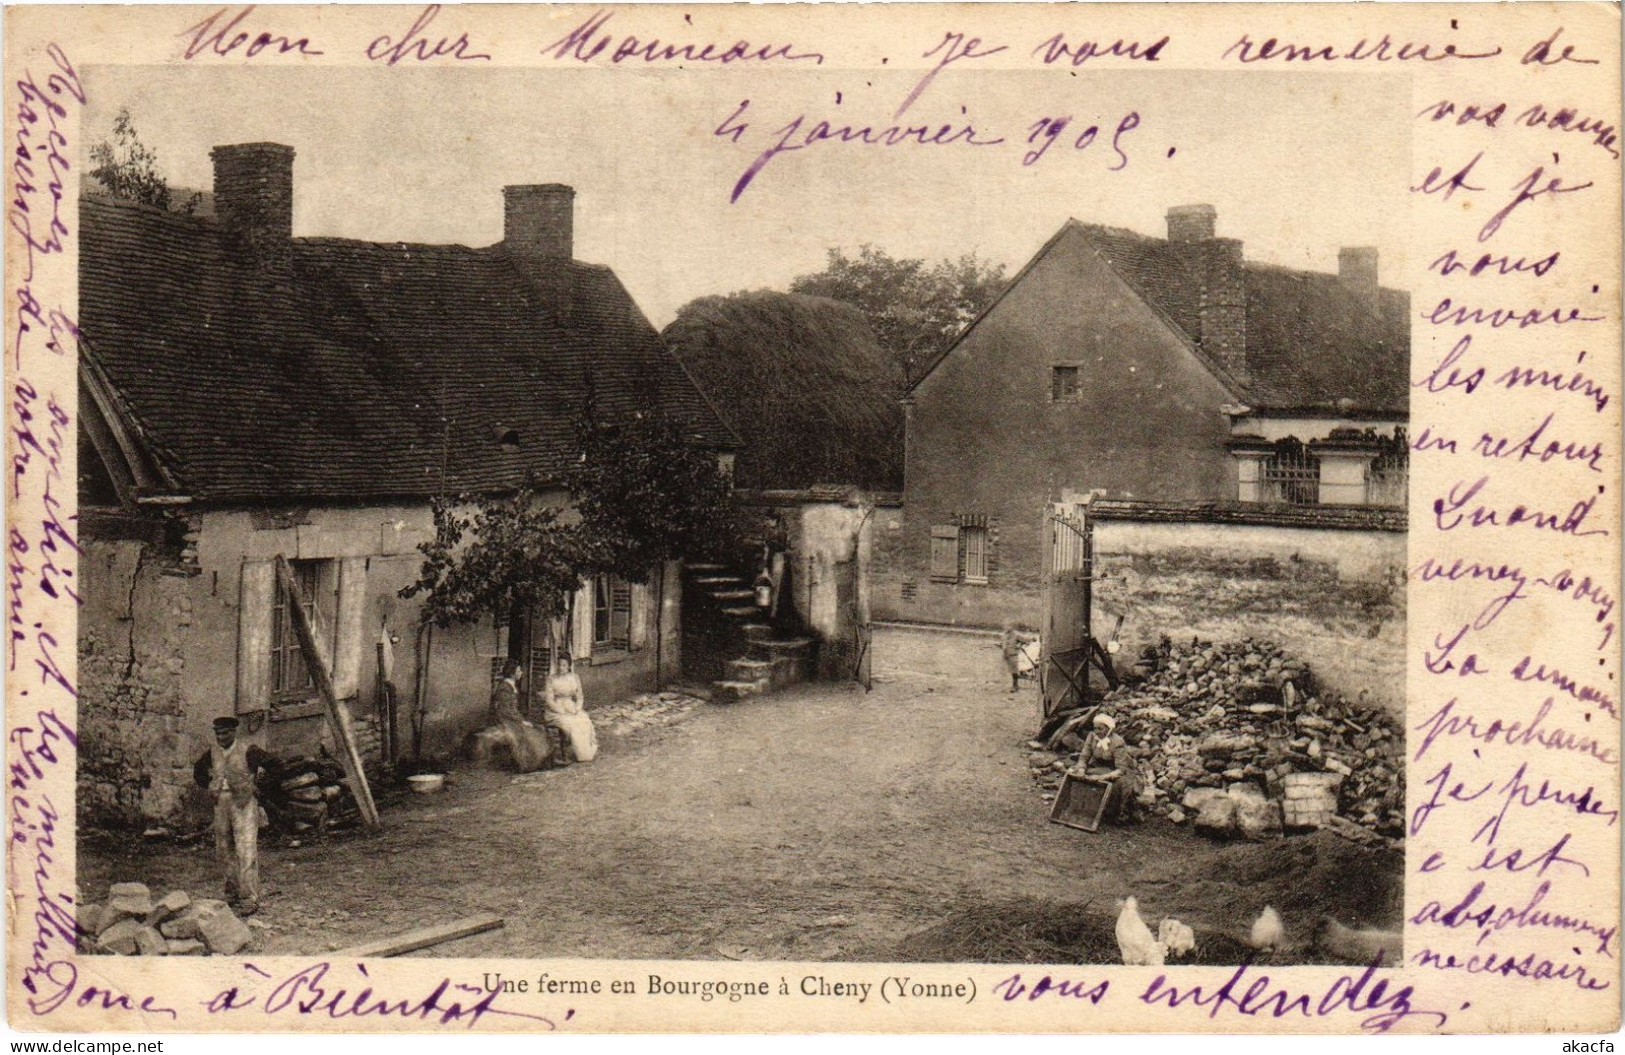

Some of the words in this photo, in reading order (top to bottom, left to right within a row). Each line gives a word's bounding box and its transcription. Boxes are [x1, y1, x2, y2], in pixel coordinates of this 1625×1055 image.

[368, 3, 491, 66] cher
[1034, 35, 1170, 69] vous
[1520, 27, 1600, 66] de
[714, 99, 749, 142] 4
[1415, 99, 1507, 128] vos
[731, 90, 1004, 204] janvier
[1410, 151, 1486, 201] et
[1428, 250, 1560, 277] vous
[16, 289, 46, 370] de
[1411, 334, 1486, 393] les
[1411, 428, 1457, 453] en
[1473, 412, 1603, 472] retour
[201, 962, 271, 1014] à
[993, 974, 1110, 1005] vous
